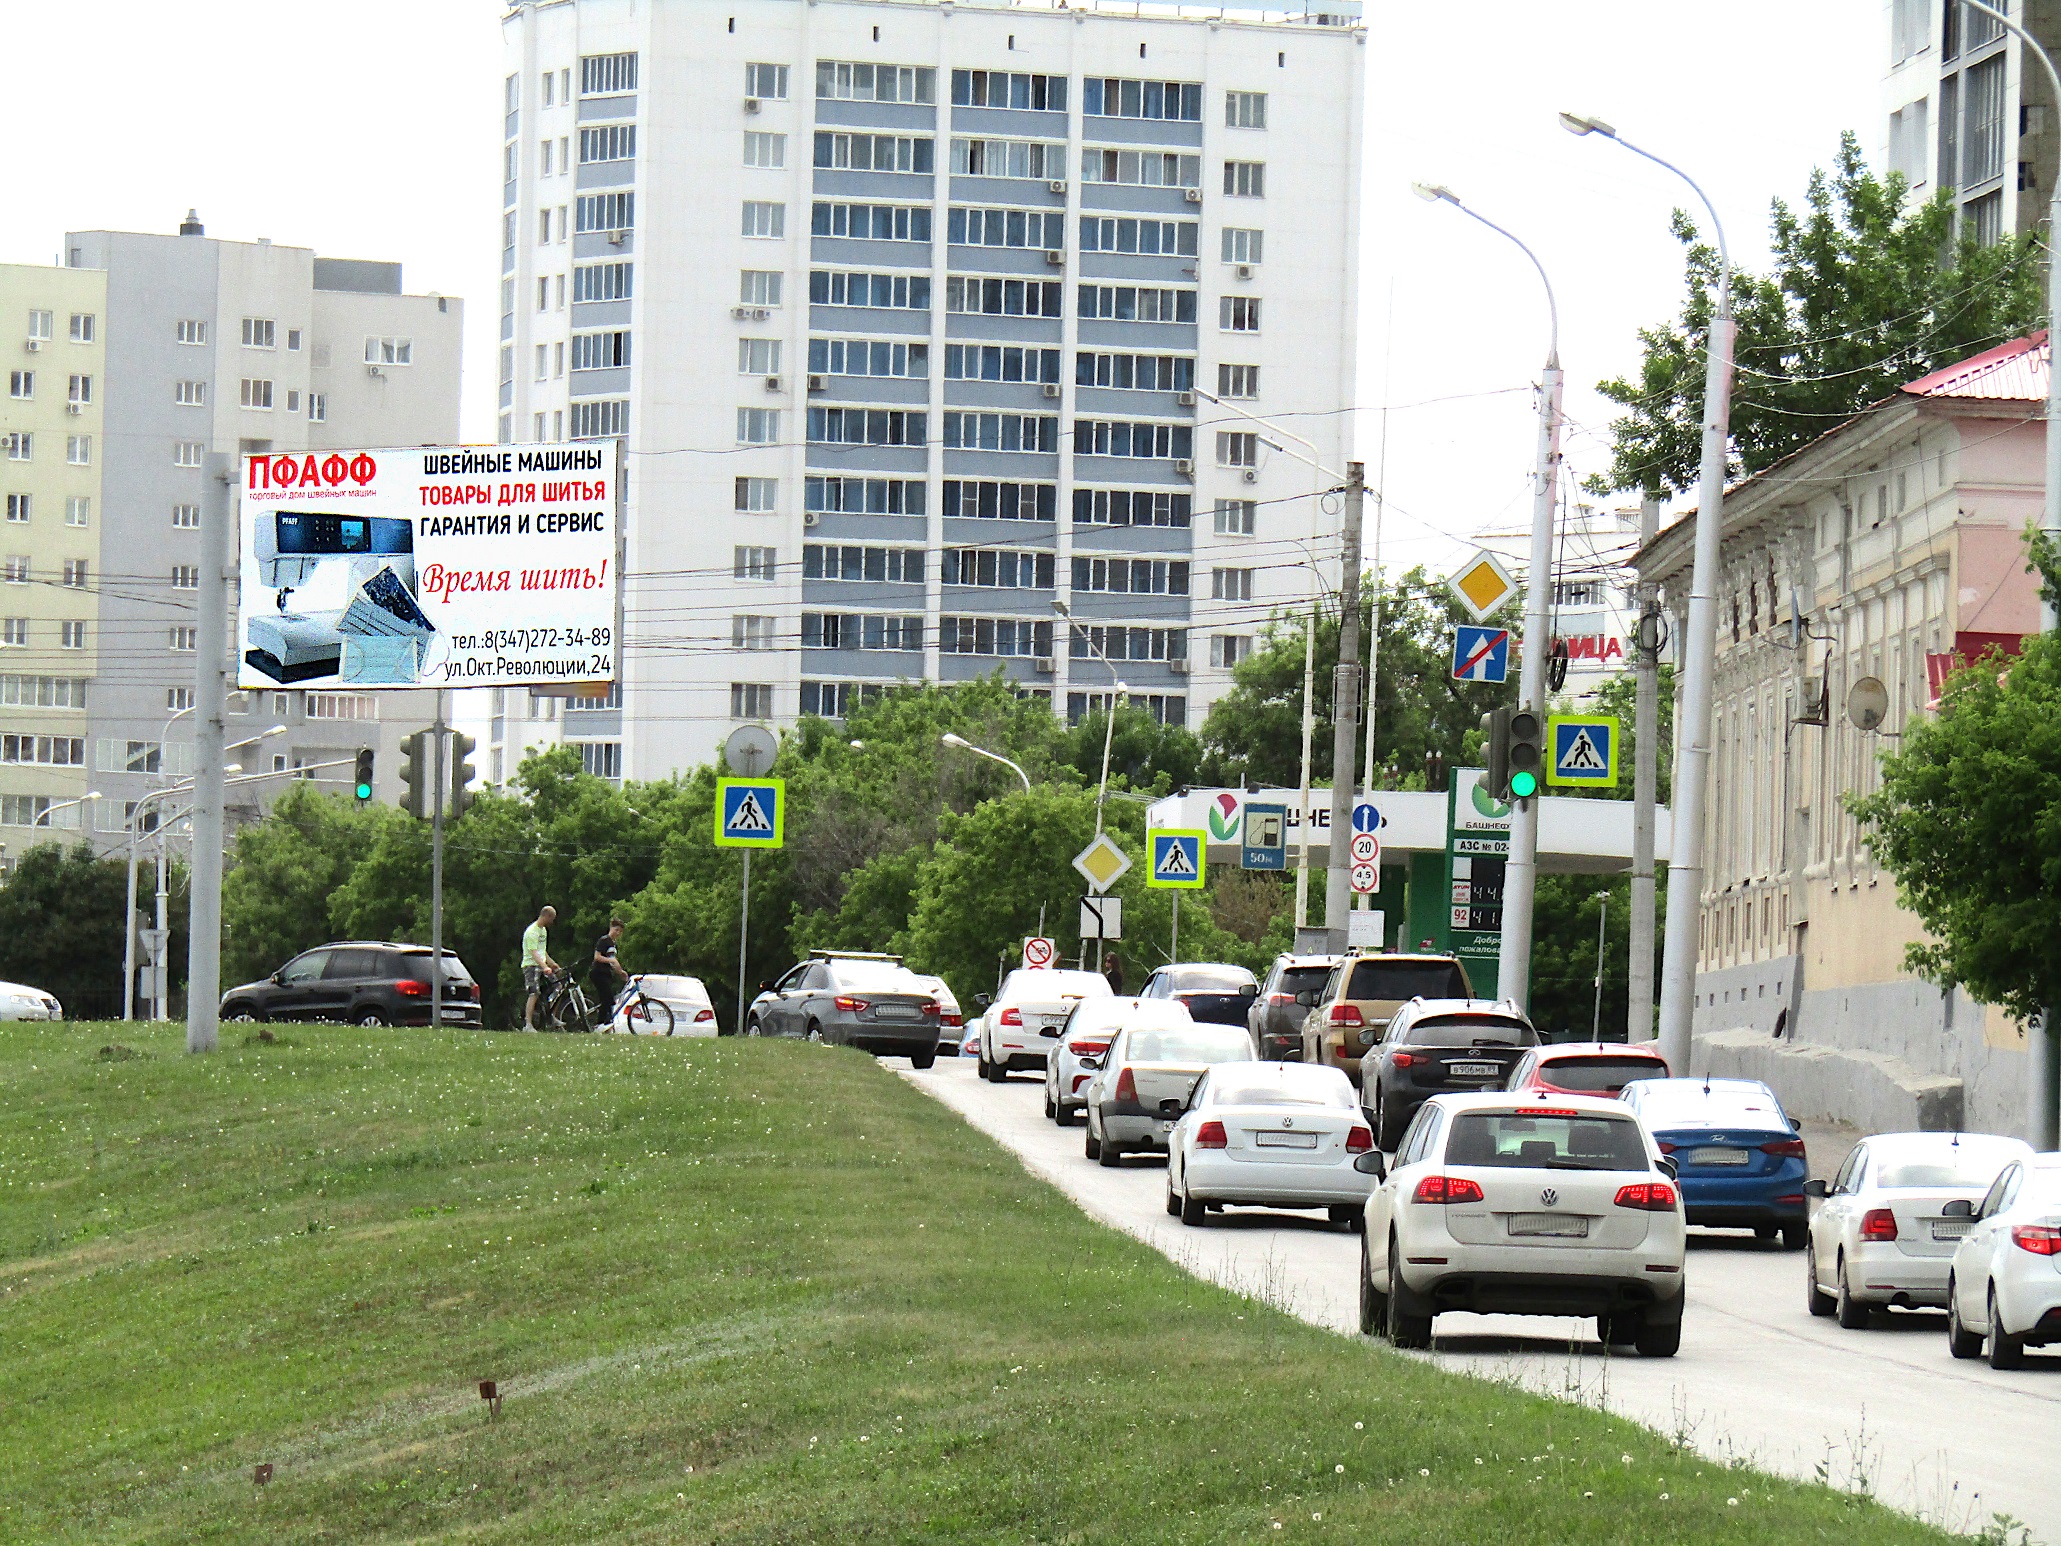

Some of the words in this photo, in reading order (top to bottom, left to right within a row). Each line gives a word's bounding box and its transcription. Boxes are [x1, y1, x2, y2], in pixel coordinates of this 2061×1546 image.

[248, 453, 377, 490] ПФАФФ
[424, 450, 511, 475] ШВЕЙНЫЕ
[518, 450, 602, 472] МАШИНЫ
[249, 490, 288, 502] торговый
[288, 490, 306, 501] дом
[307, 488, 347, 499] швейных
[348, 488, 377, 498] машин
[419, 484, 490, 506] ТОВАРЫ
[497, 482, 536, 507] ДЛЯ
[542, 480, 606, 503] ШИТЬЯ
[420, 514, 511, 537] ГАРАНТИЯ
[518, 514, 530, 535] И
[536, 512, 604, 534] СЕРВИС
[422, 563, 511, 604] Время
[520, 559, 608, 592] шить!
[1466, 821, 1511, 830] БАШНЕФ
[1358, 841, 1372, 854] 20
[1454, 908, 1467, 921] 92
